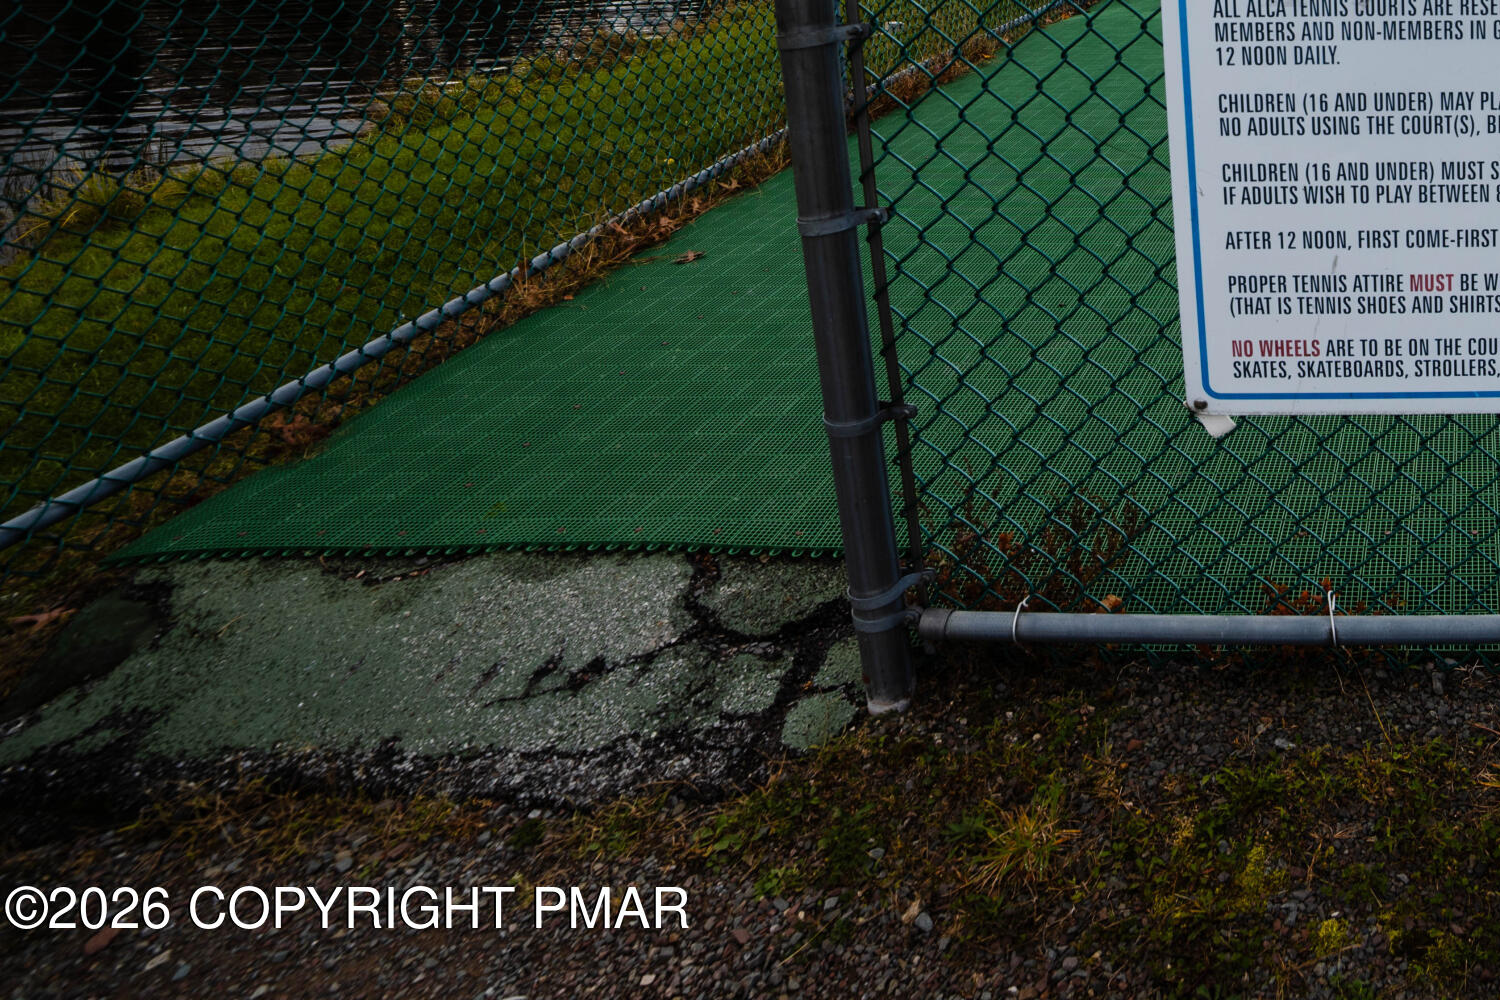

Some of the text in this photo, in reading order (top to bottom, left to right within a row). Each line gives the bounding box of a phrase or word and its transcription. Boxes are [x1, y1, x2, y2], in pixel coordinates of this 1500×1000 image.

[1214, 21, 1295, 42] MEMBERS
[1301, 21, 1334, 41] AND
[1341, 19, 1463, 41] NON-MEMBERS
[1470, 19, 1485, 39] IN
[1216, 45, 1339, 66] 12 NOON DAILY.
[1218, 93, 1295, 113] CHILDREN
[1302, 93, 1328, 115] (16
[1334, 92, 1366, 112] AND
[1374, 91, 1433, 114] UNDER)
[1440, 91, 1474, 111] MAY
[1219, 116, 1241, 136] NO
[1247, 116, 1305, 136] ADULTS
[1311, 115, 1359, 135] USING
[1366, 115, 1394, 134] THE
[1401, 114, 1480, 137] COURT(S),
[1222, 162, 1298, 182] CHILDREN
[1305, 162, 1330, 184] (16
[1336, 162, 1368, 181] AND
[1375, 161, 1434, 183] UNDER)
[1441, 160, 1484, 180] MUST
[1223, 186, 1236, 205] IF
[1241, 185, 1298, 205] ADULTS
[1303, 185, 1344, 204] WISH
[1350, 184, 1369, 204] TO
[1376, 184, 1412, 203] PLAY
[1418, 183, 1489, 203] BETWEEN
[1225, 231, 1271, 249] AFTER
[1278, 231, 1296, 249] 12
[1302, 230, 1351, 250] NOON,
[1358, 229, 1399, 248] FIRST
[1406, 228, 1498, 248] COME-FIRST
[1228, 275, 1286, 293] PROPER
[1292, 274, 1347, 293] TENNIS
[1352, 274, 1403, 292] ATTIRE
[1410, 273, 1453, 291] MUST
[1460, 273, 1478, 291] BE
[1230, 296, 1271, 318] (THAT
[1277, 296, 1291, 315] IS
[1296, 296, 1351, 314] TENNIS
[1357, 295, 1406, 314] SHOES
[1411, 295, 1443, 313] AND
[1232, 339, 1253, 357] NO
[1259, 339, 1320, 357] WHEELS
[1326, 339, 1354, 357] ARE
[1359, 338, 1377, 357] TO
[1384, 338, 1402, 356] BE
[1408, 338, 1428, 356] ON
[1434, 338, 1461, 356] THE
[1233, 360, 1291, 379] SKATES,
[1297, 359, 1408, 378] SKATEBOARDS,
[1414, 358, 1500, 377] STROLLERS,
